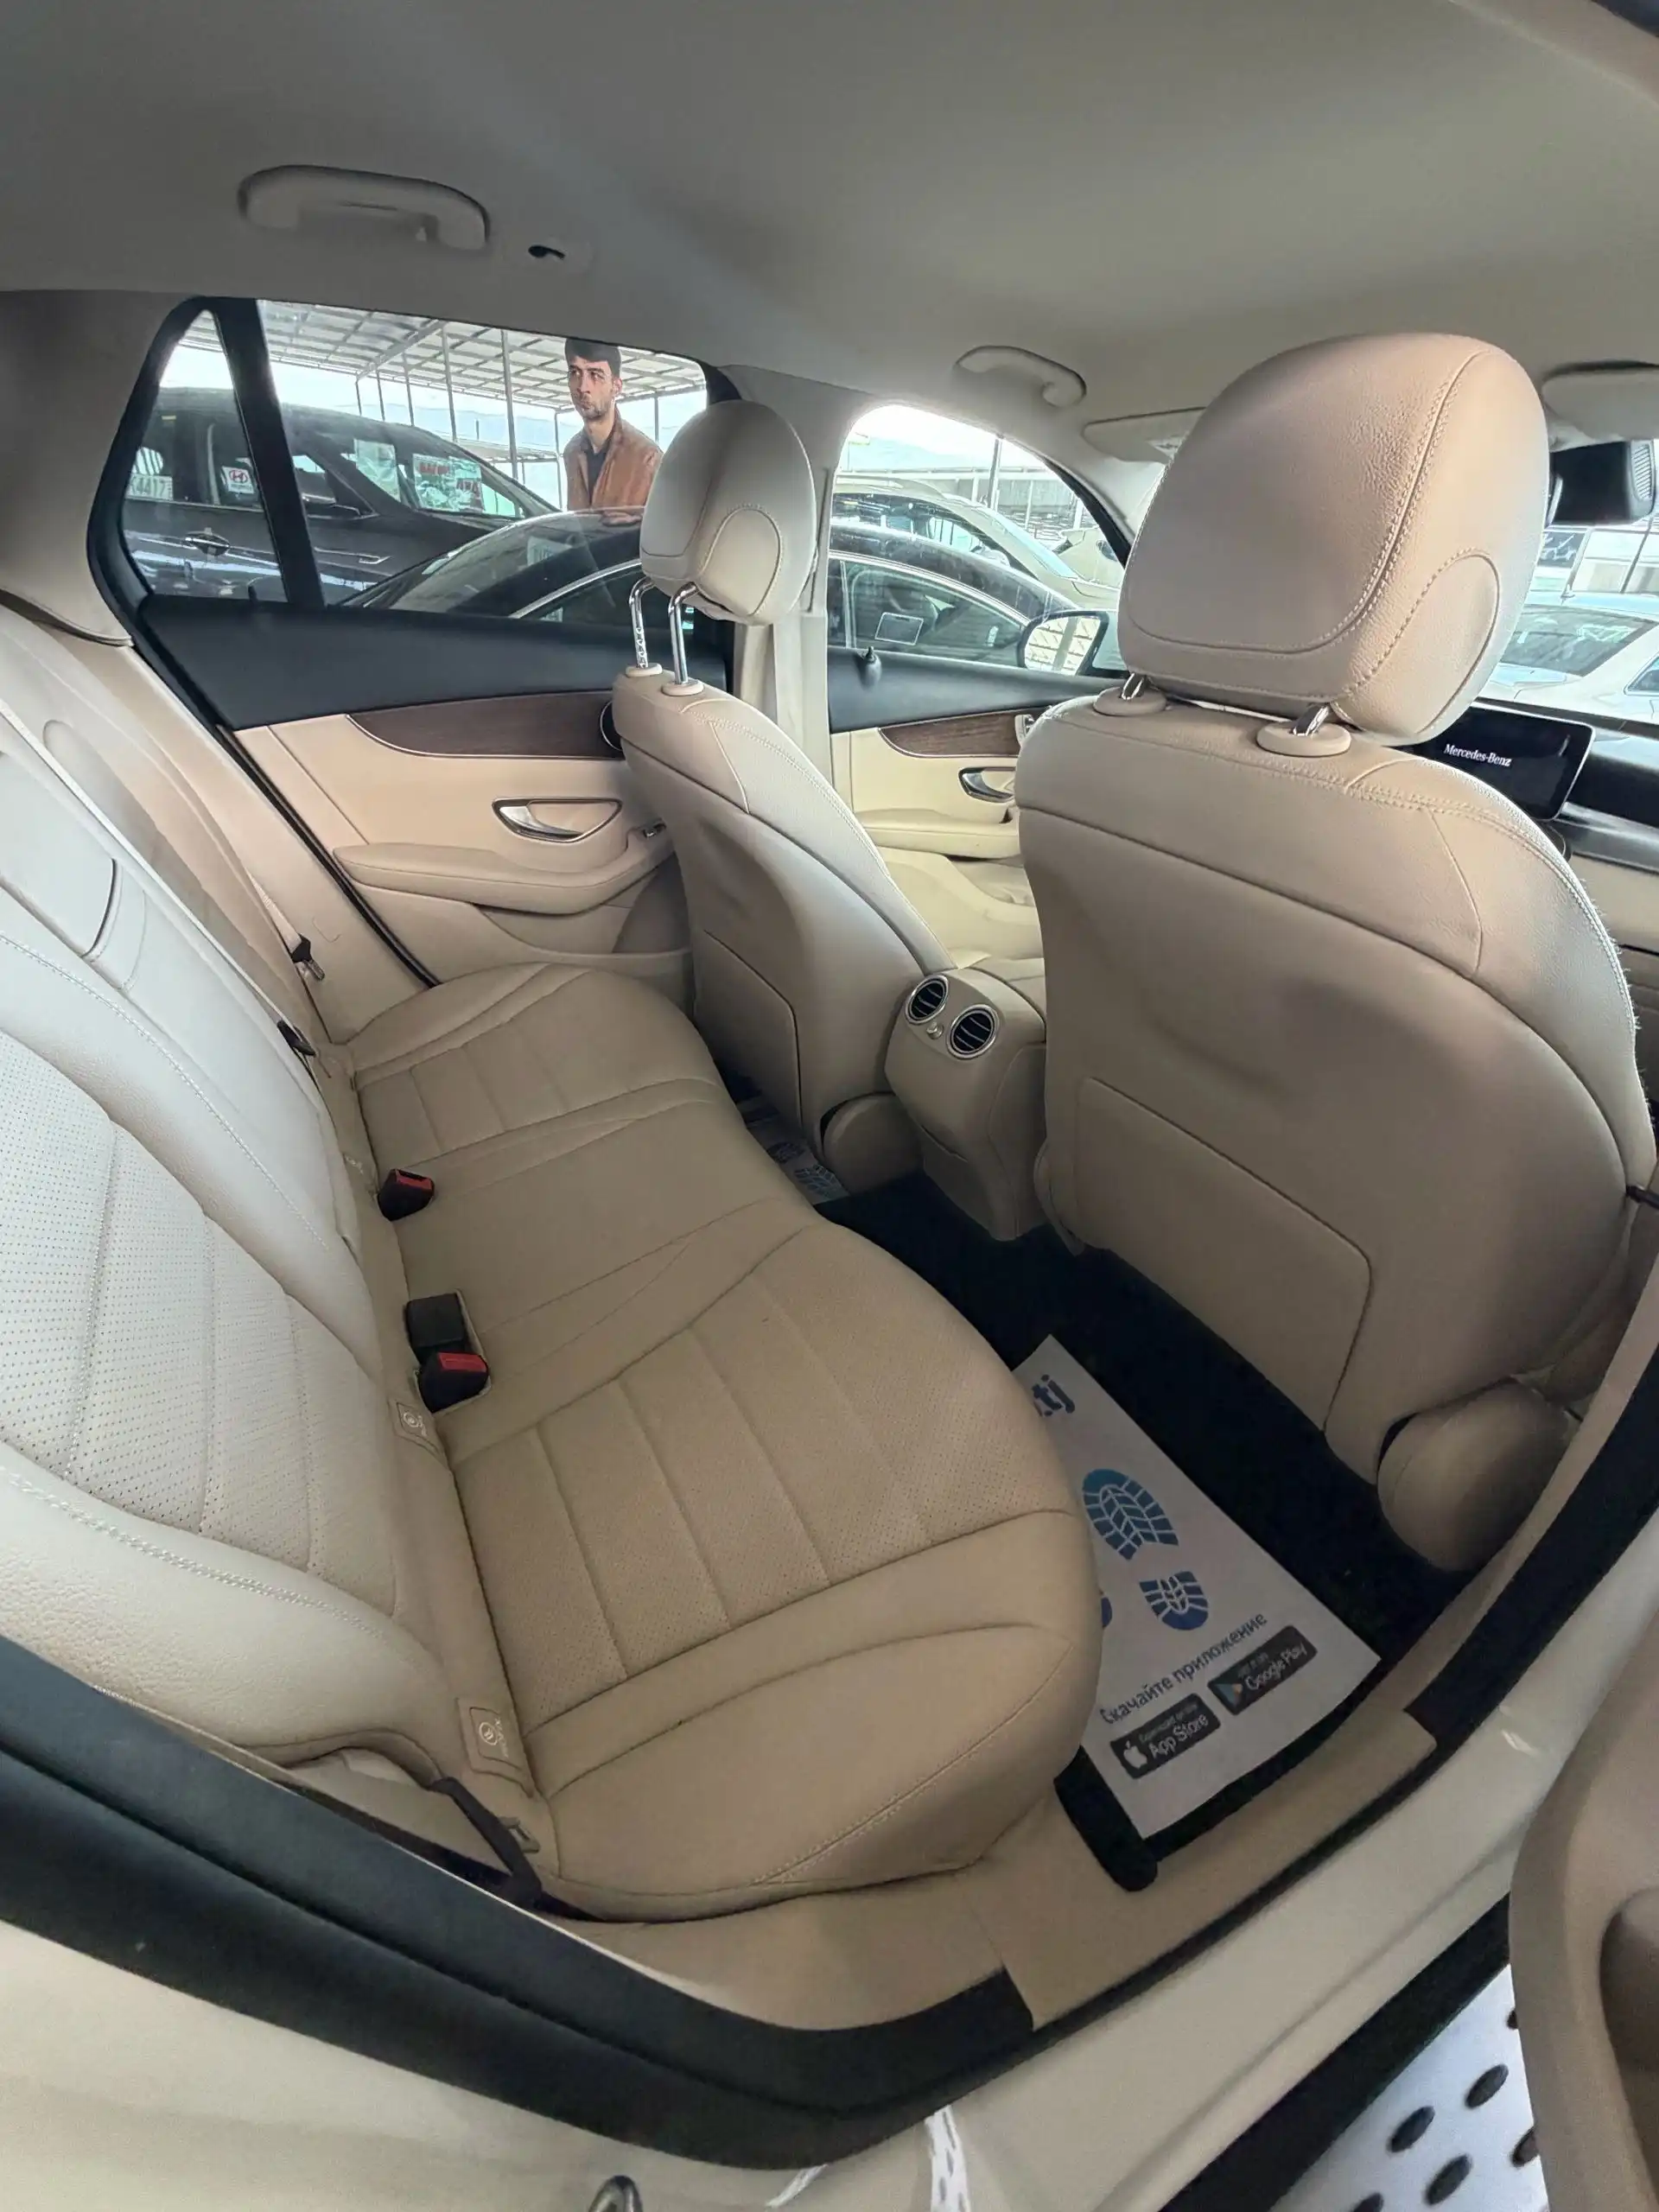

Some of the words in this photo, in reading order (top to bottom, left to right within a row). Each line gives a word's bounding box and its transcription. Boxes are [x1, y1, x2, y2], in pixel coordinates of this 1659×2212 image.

[1444, 744, 1512, 767] Mercedes-Benz
[1100, 1678, 1173, 1724] Скачайте
[1172, 1614, 1268, 1681] приложение
[1148, 1736, 1177, 1758] App
[1173, 1713, 1209, 1742] Store
